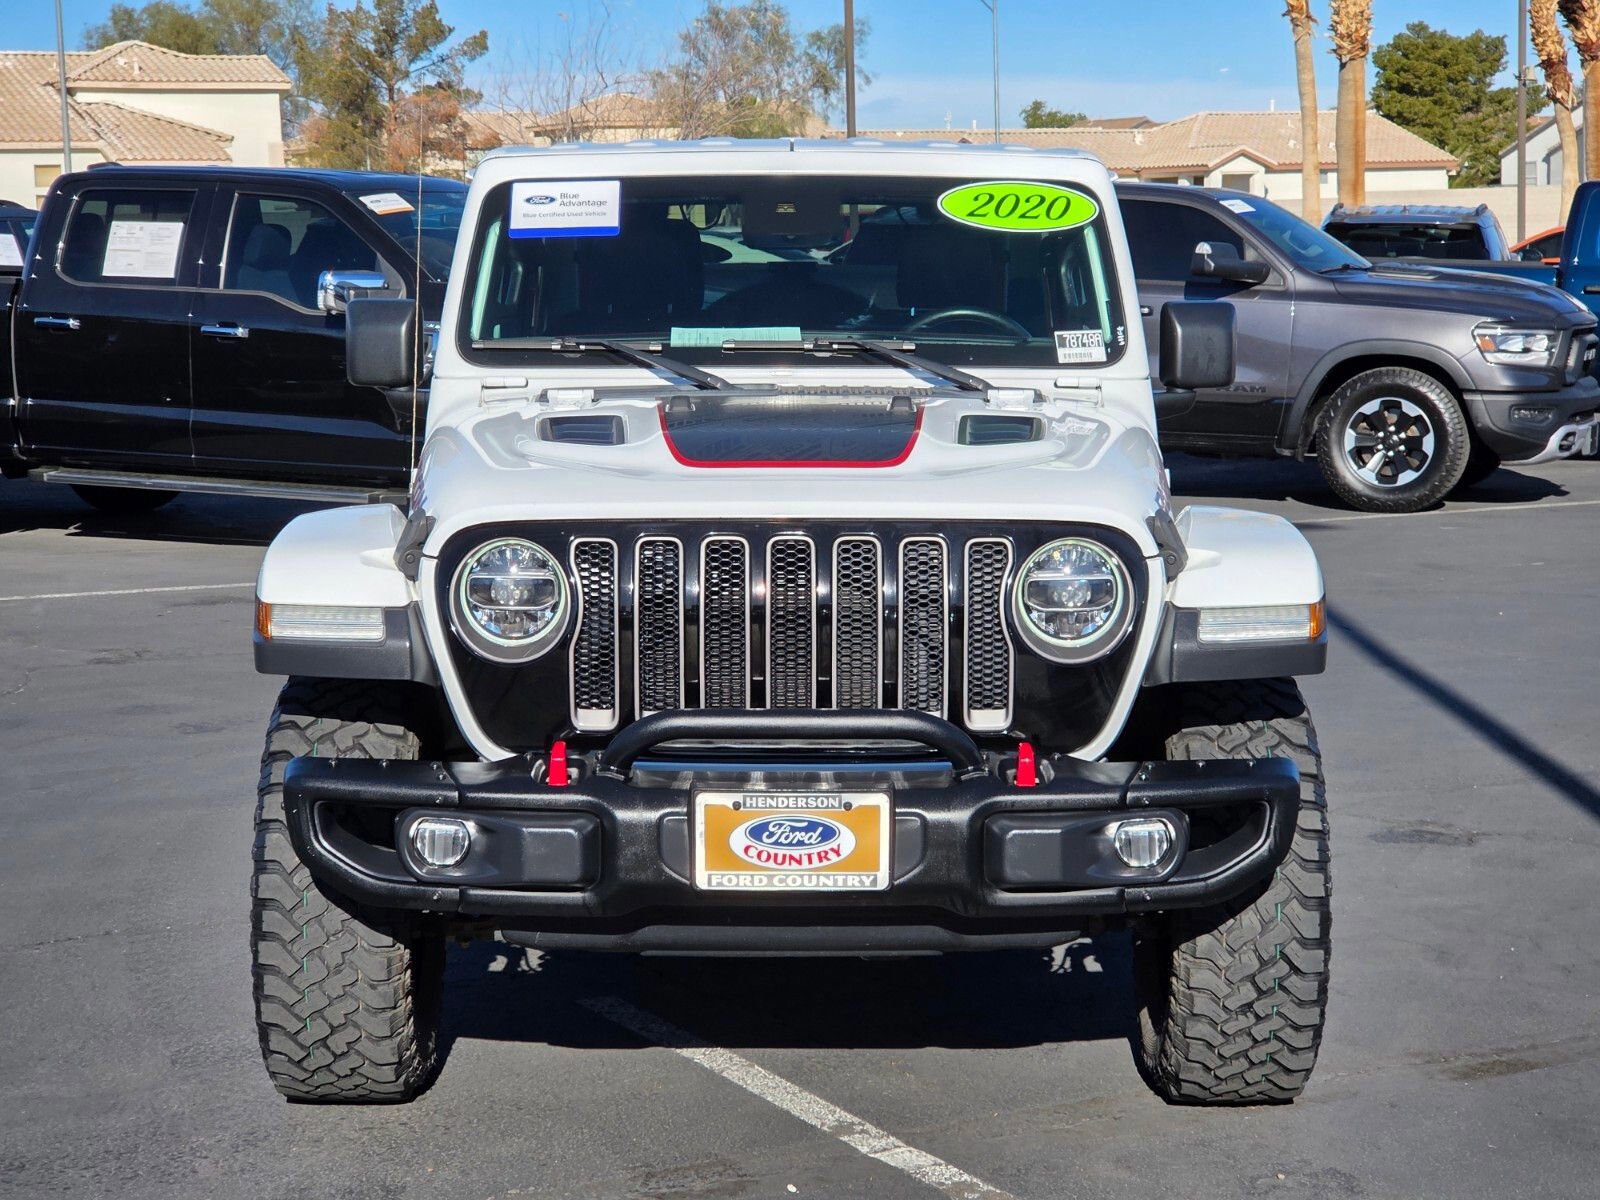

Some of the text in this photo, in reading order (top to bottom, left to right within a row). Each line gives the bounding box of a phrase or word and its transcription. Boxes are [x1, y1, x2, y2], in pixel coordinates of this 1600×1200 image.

[966, 192, 1071, 221] 2020
[745, 797, 840, 809] HENDERSON
[762, 820, 823, 846] Ford
[743, 844, 843, 867] COUNTRY
[711, 874, 876, 888] FORD COUNTRY
